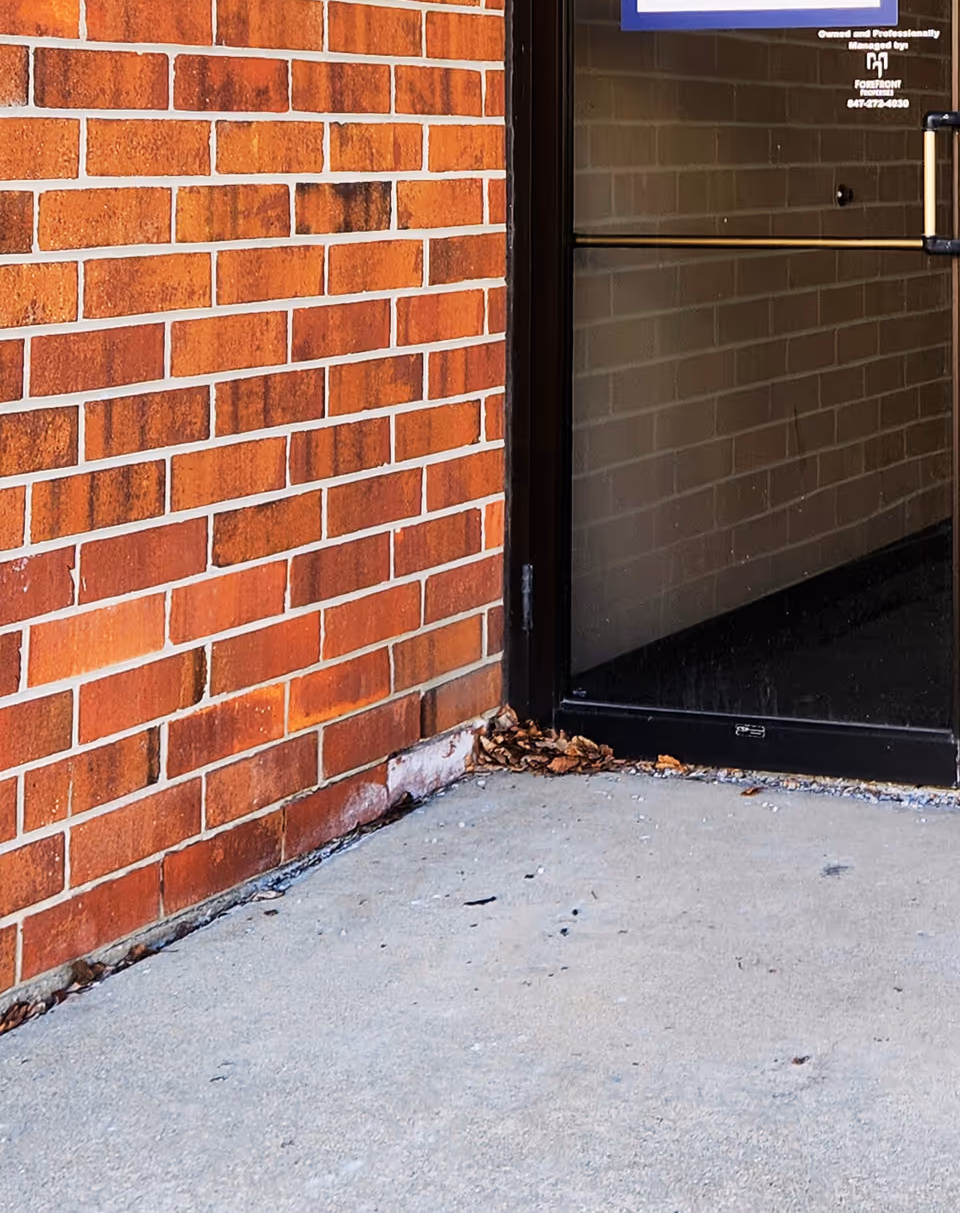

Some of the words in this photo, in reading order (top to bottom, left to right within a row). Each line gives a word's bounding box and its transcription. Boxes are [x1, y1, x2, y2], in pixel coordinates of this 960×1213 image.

[818, 29, 851, 39] Owned
[853, 29, 871, 38] and
[873, 29, 940, 39] Professionally
[848, 41, 892, 51] Managed
